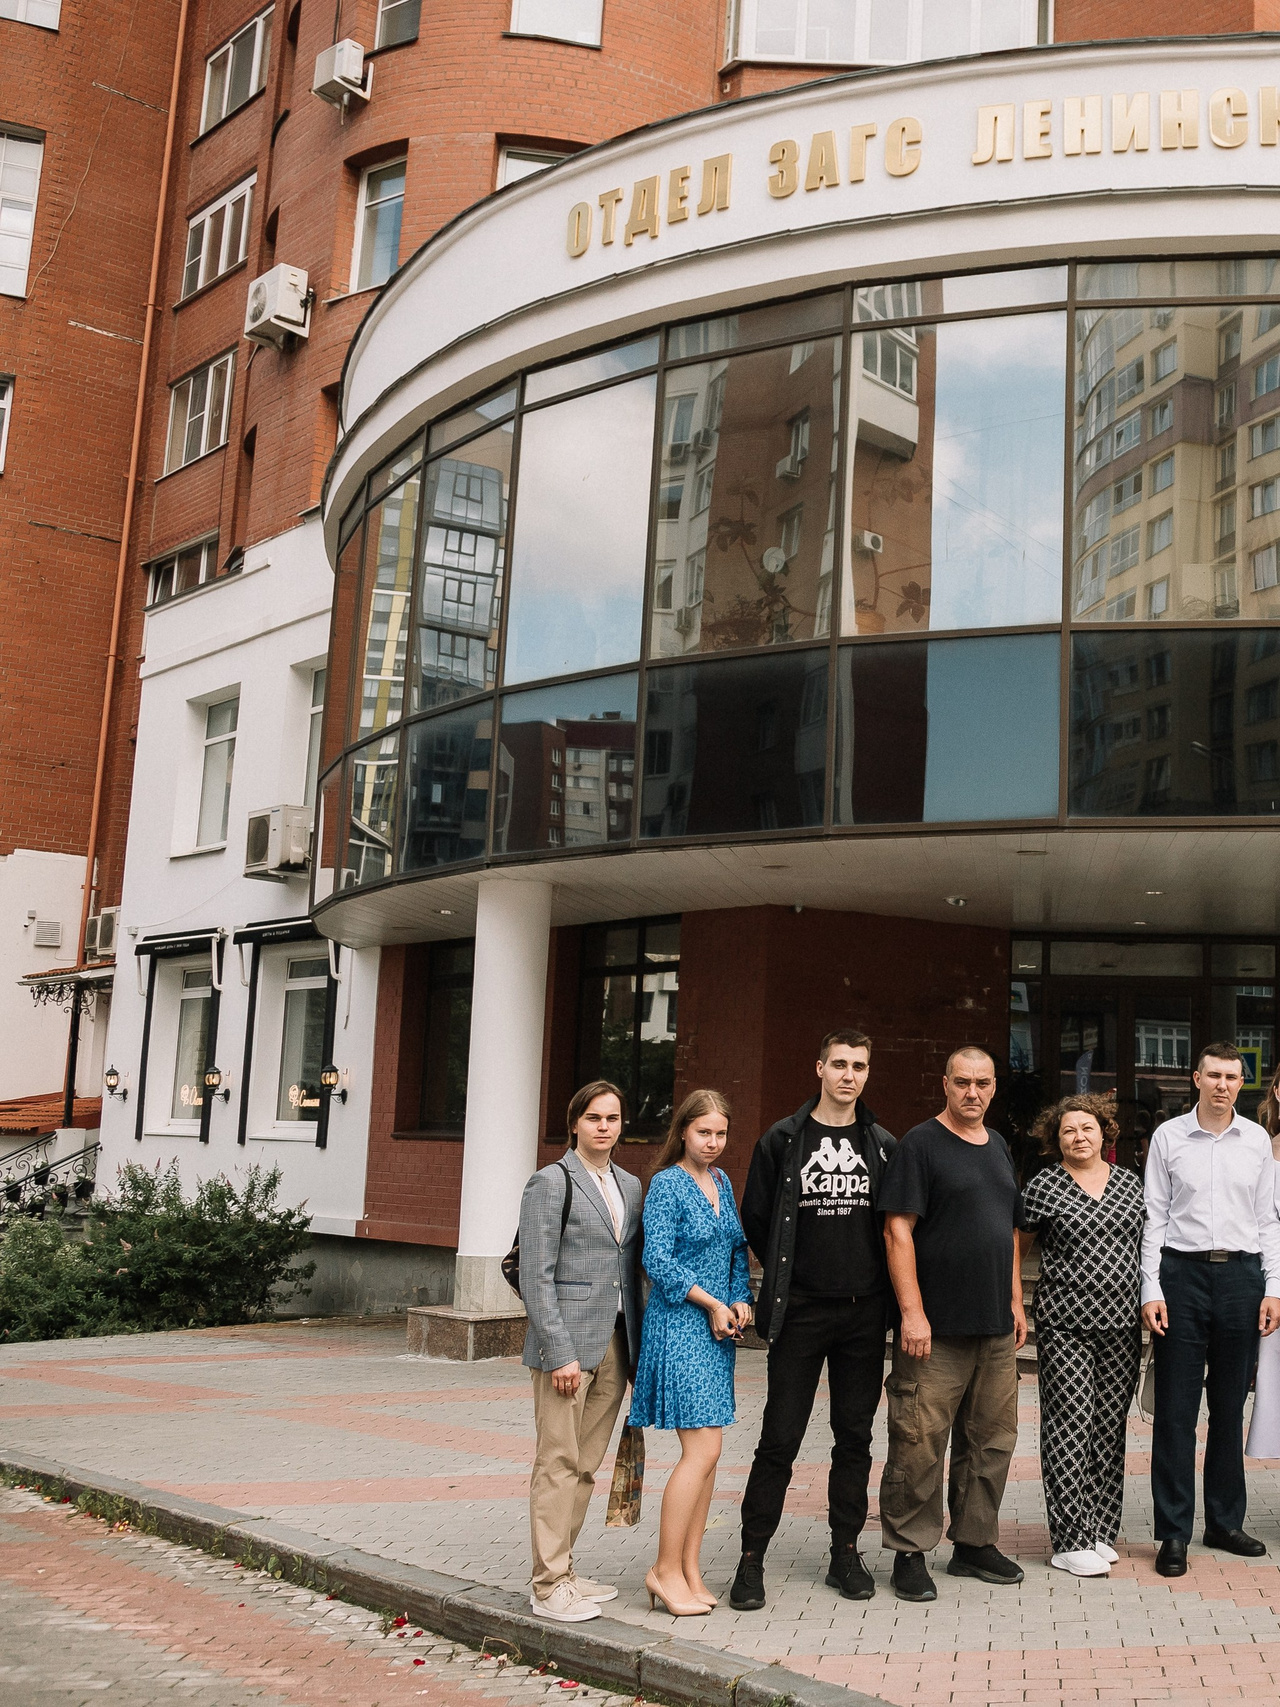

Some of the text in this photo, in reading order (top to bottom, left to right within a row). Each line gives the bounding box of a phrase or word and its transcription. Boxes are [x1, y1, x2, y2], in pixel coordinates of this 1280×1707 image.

[566, 153, 733, 257] ОТДЕЛ
[768, 116, 923, 199] ЗАГС
[800, 1172, 870, 1197] Kappa
[822, 1198, 858, 1206] Sportswear
